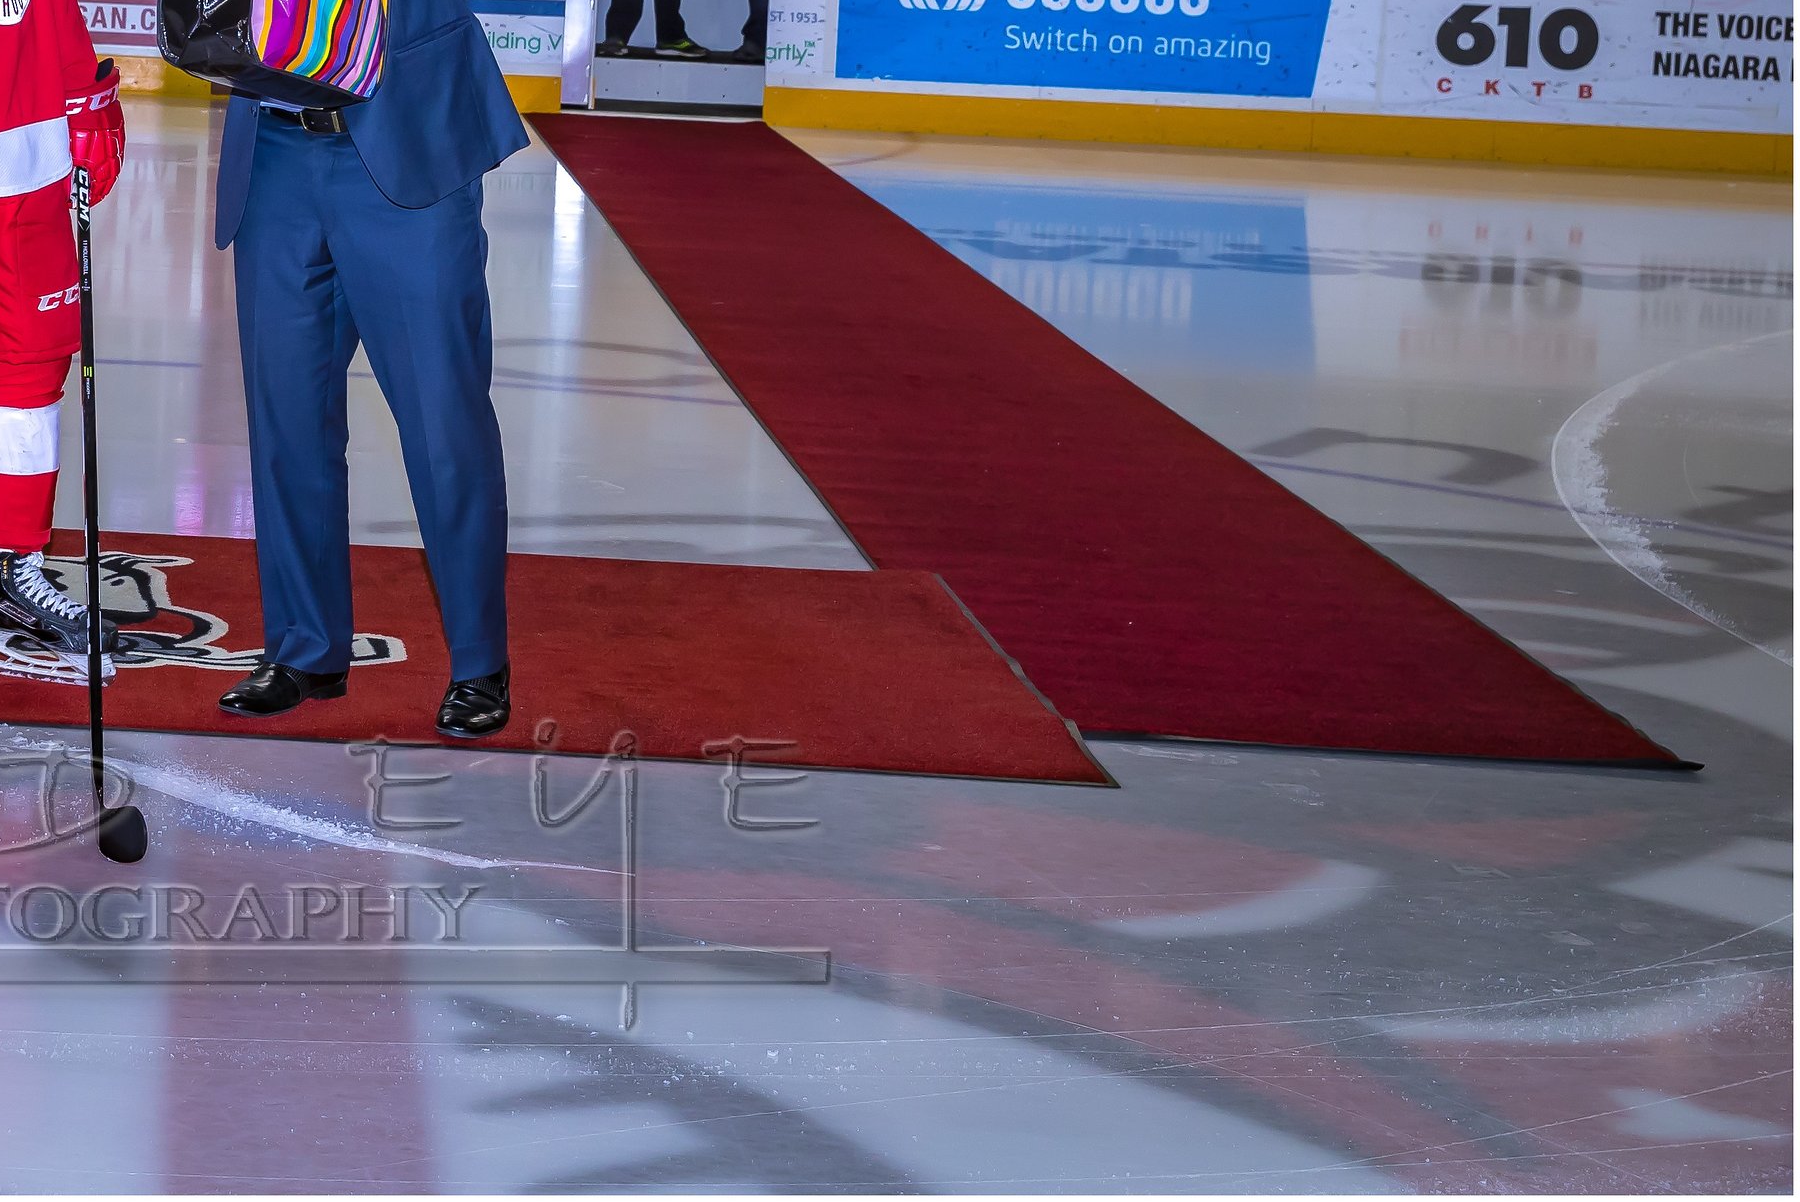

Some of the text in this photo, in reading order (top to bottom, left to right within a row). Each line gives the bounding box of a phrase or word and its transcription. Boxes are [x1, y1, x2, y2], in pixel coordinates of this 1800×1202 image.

[1436, 4, 1599, 71] 610
[1655, 11, 1793, 42] THE VOICE
[1004, 25, 1272, 66] Switch on amazing
[1653, 51, 1780, 82] NIAGARA
[77, 169, 91, 223] CCM
[37, 282, 82, 313] CC
